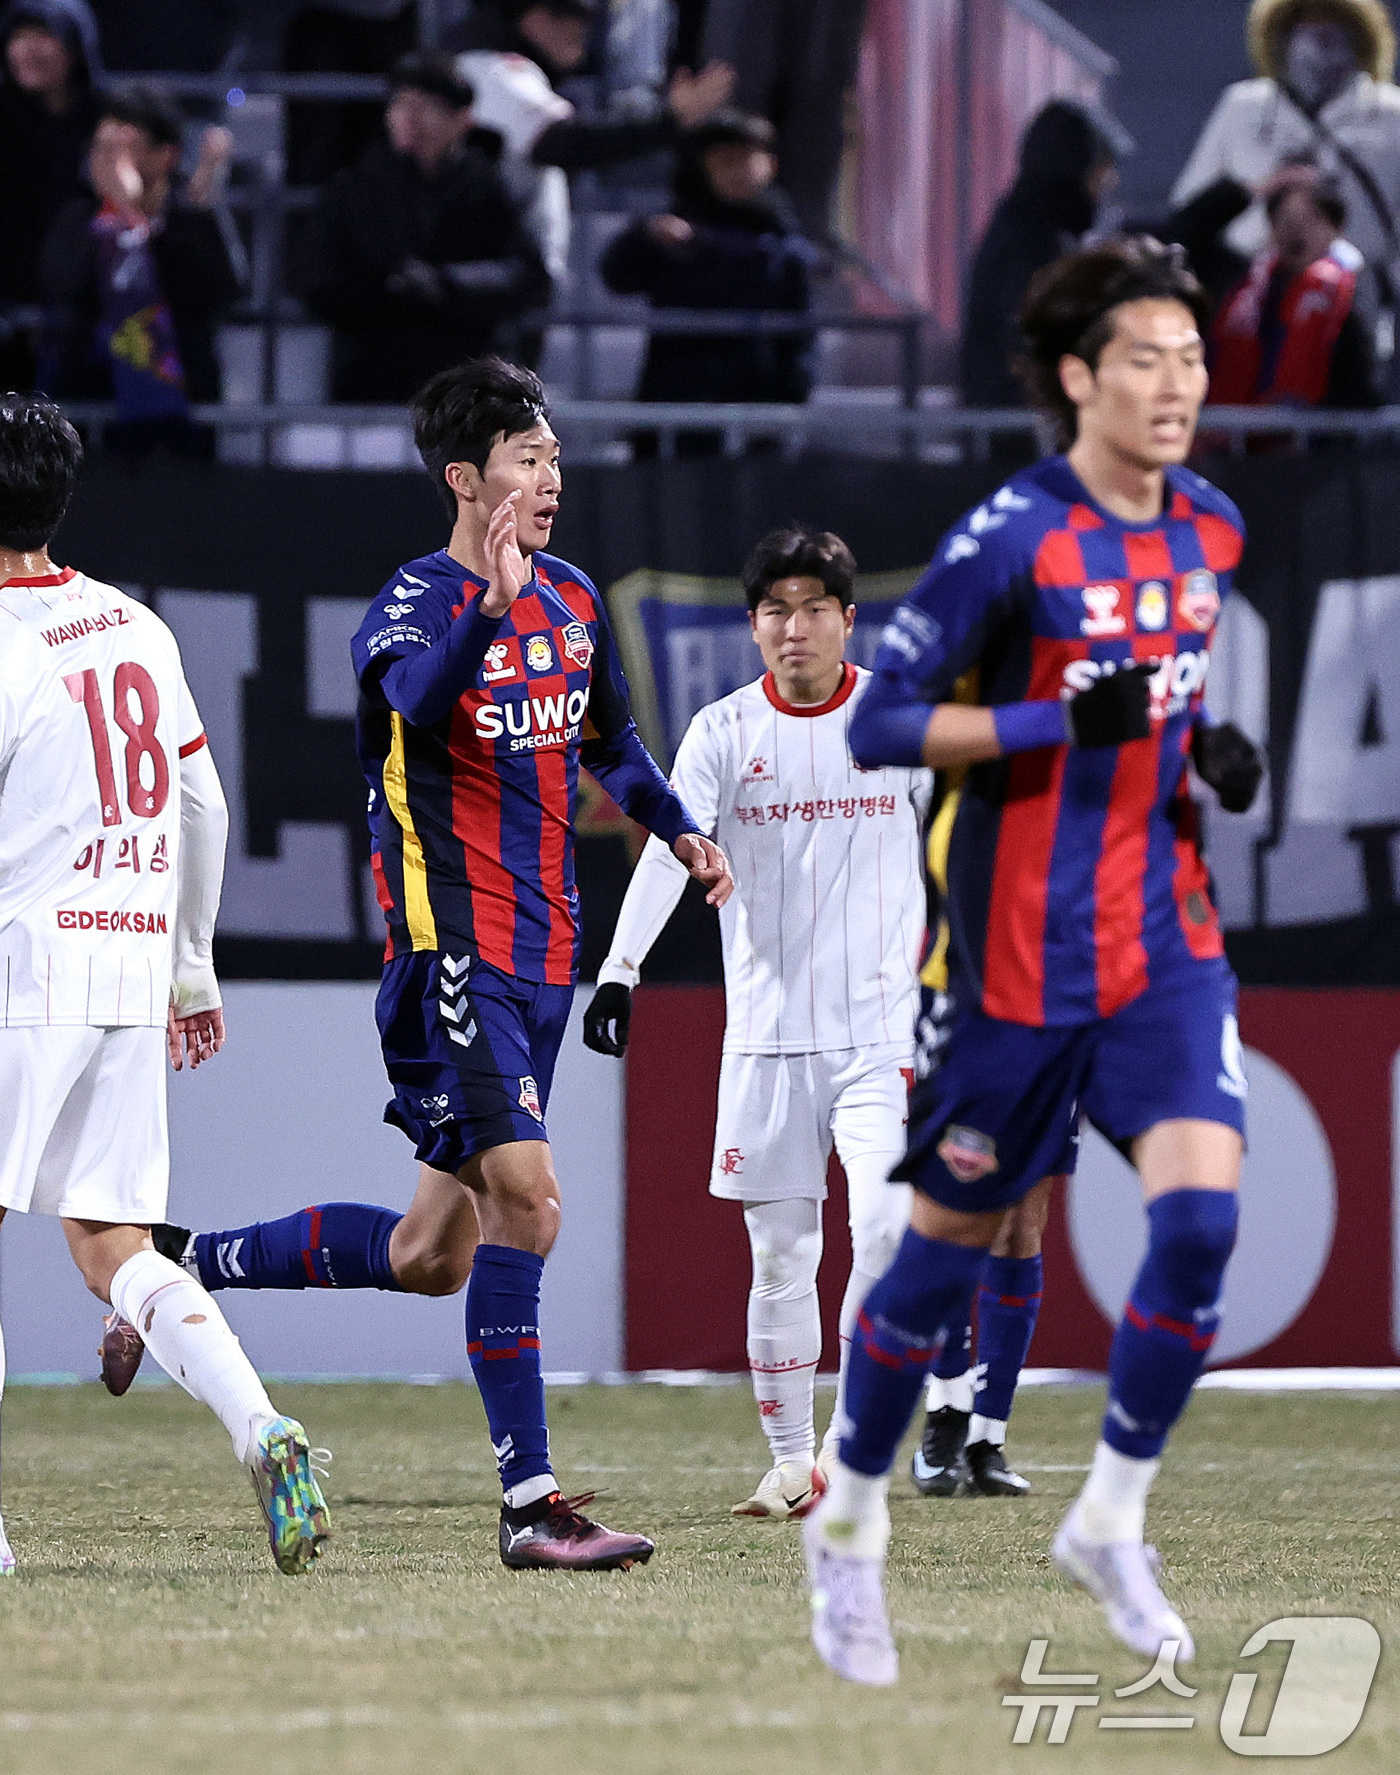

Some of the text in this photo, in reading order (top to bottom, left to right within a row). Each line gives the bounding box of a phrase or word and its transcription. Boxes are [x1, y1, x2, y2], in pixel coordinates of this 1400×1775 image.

[40, 606, 137, 648] WAWABUZA
[61, 661, 170, 828] 18
[510, 731, 564, 752] SPECIAL
[78, 909, 168, 935] DEOKSAN
